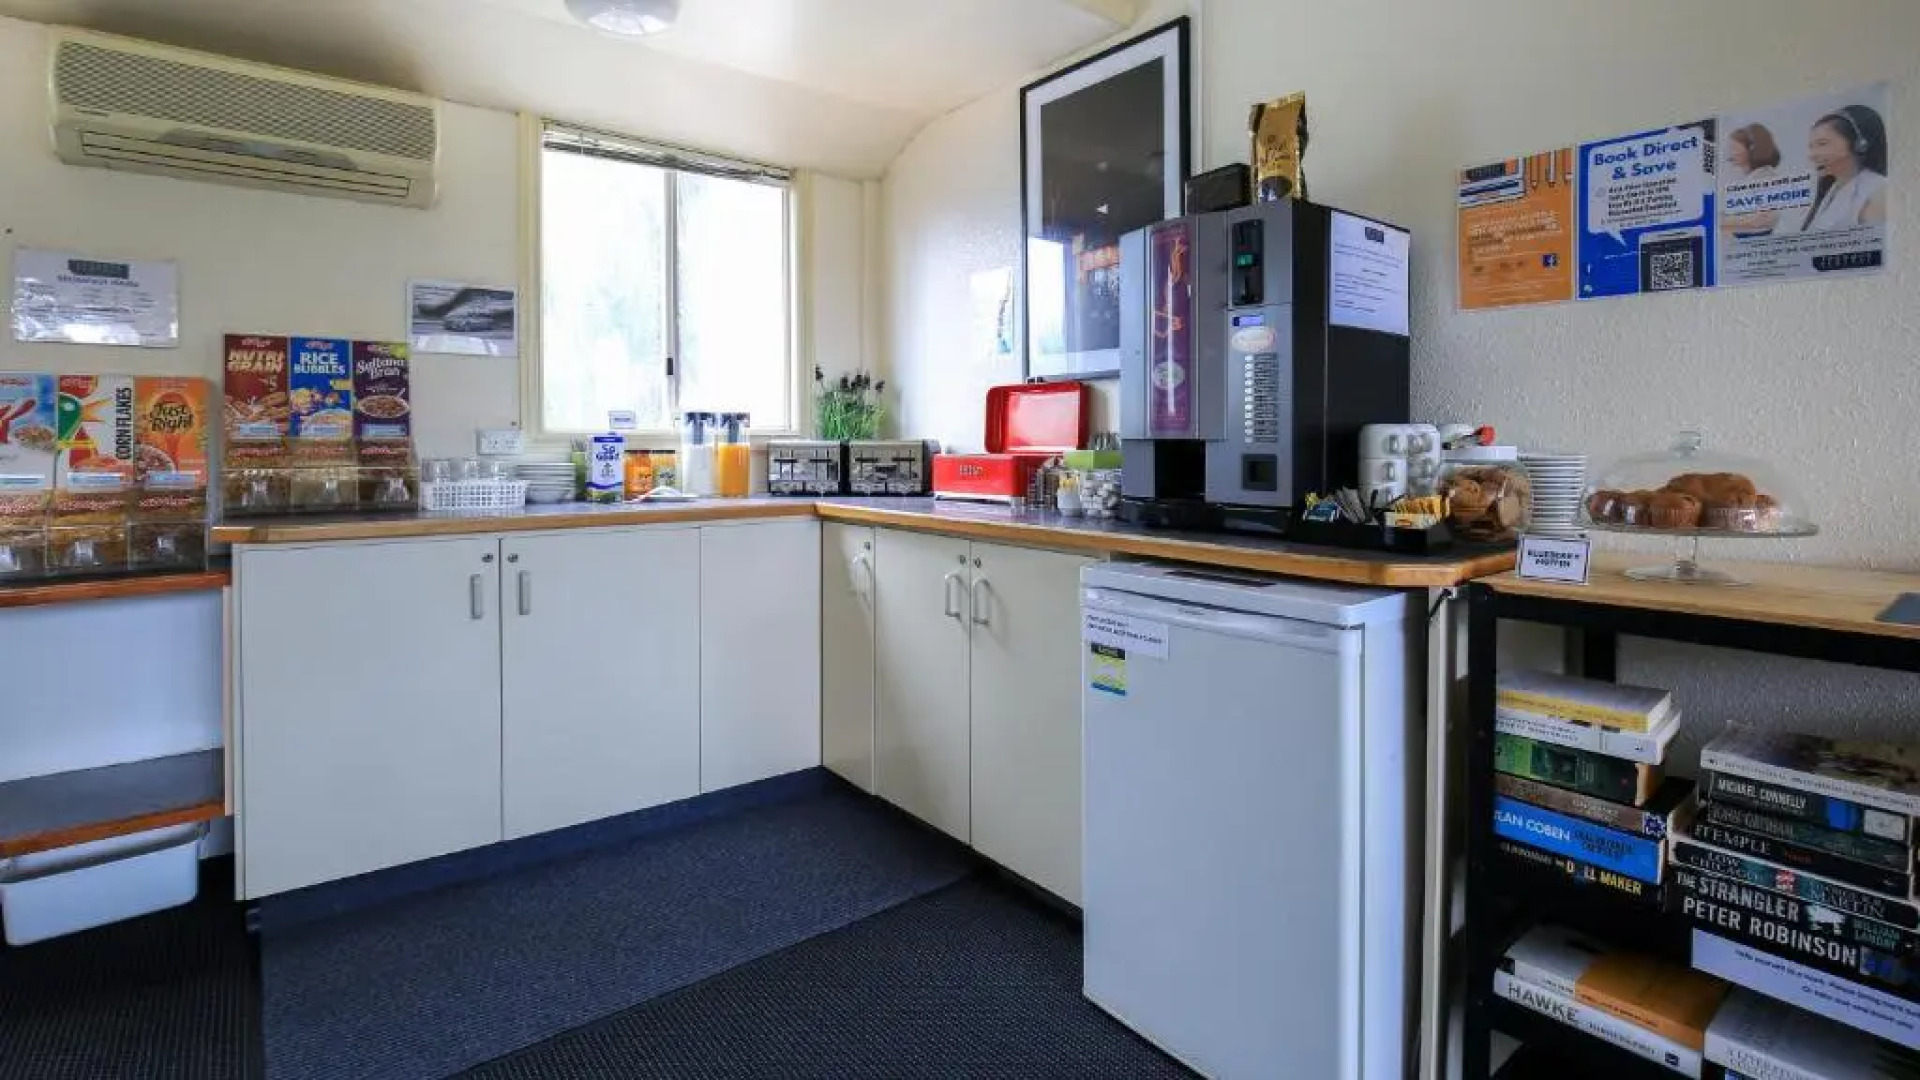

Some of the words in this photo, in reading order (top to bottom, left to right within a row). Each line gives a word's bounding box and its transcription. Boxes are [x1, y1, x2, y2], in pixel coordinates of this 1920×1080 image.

[1594, 147, 1637, 166] Book
[1643, 136, 1698, 157] Direct
[1612, 166, 1626, 181] &
[1631, 160, 1677, 177] Save
[1726, 194, 1765, 209] SAVE
[1767, 188, 1810, 203] MORE
[293, 364, 346, 375] BUBBLES
[300, 351, 339, 365] RICE
[356, 357, 406, 374] Sultana
[116, 387, 132, 430] FLAKES
[155, 403, 190, 418] Just
[151, 415, 193, 432] Right
[116, 431, 132, 460] CORN
[601, 444, 616, 453] So
[1717, 778, 1758, 798] MICHAEL
[1759, 786, 1807, 809] CONNELLY
[1526, 818, 1571, 842] COBEN
[1599, 871, 1643, 896] MAKER
[1676, 872, 1696, 890] THE
[1699, 874, 1800, 923] STRANGLER
[1683, 897, 1741, 931] PETER
[1749, 916, 1858, 967] ROBINSON
[1508, 981, 1578, 1020] HAWKE
